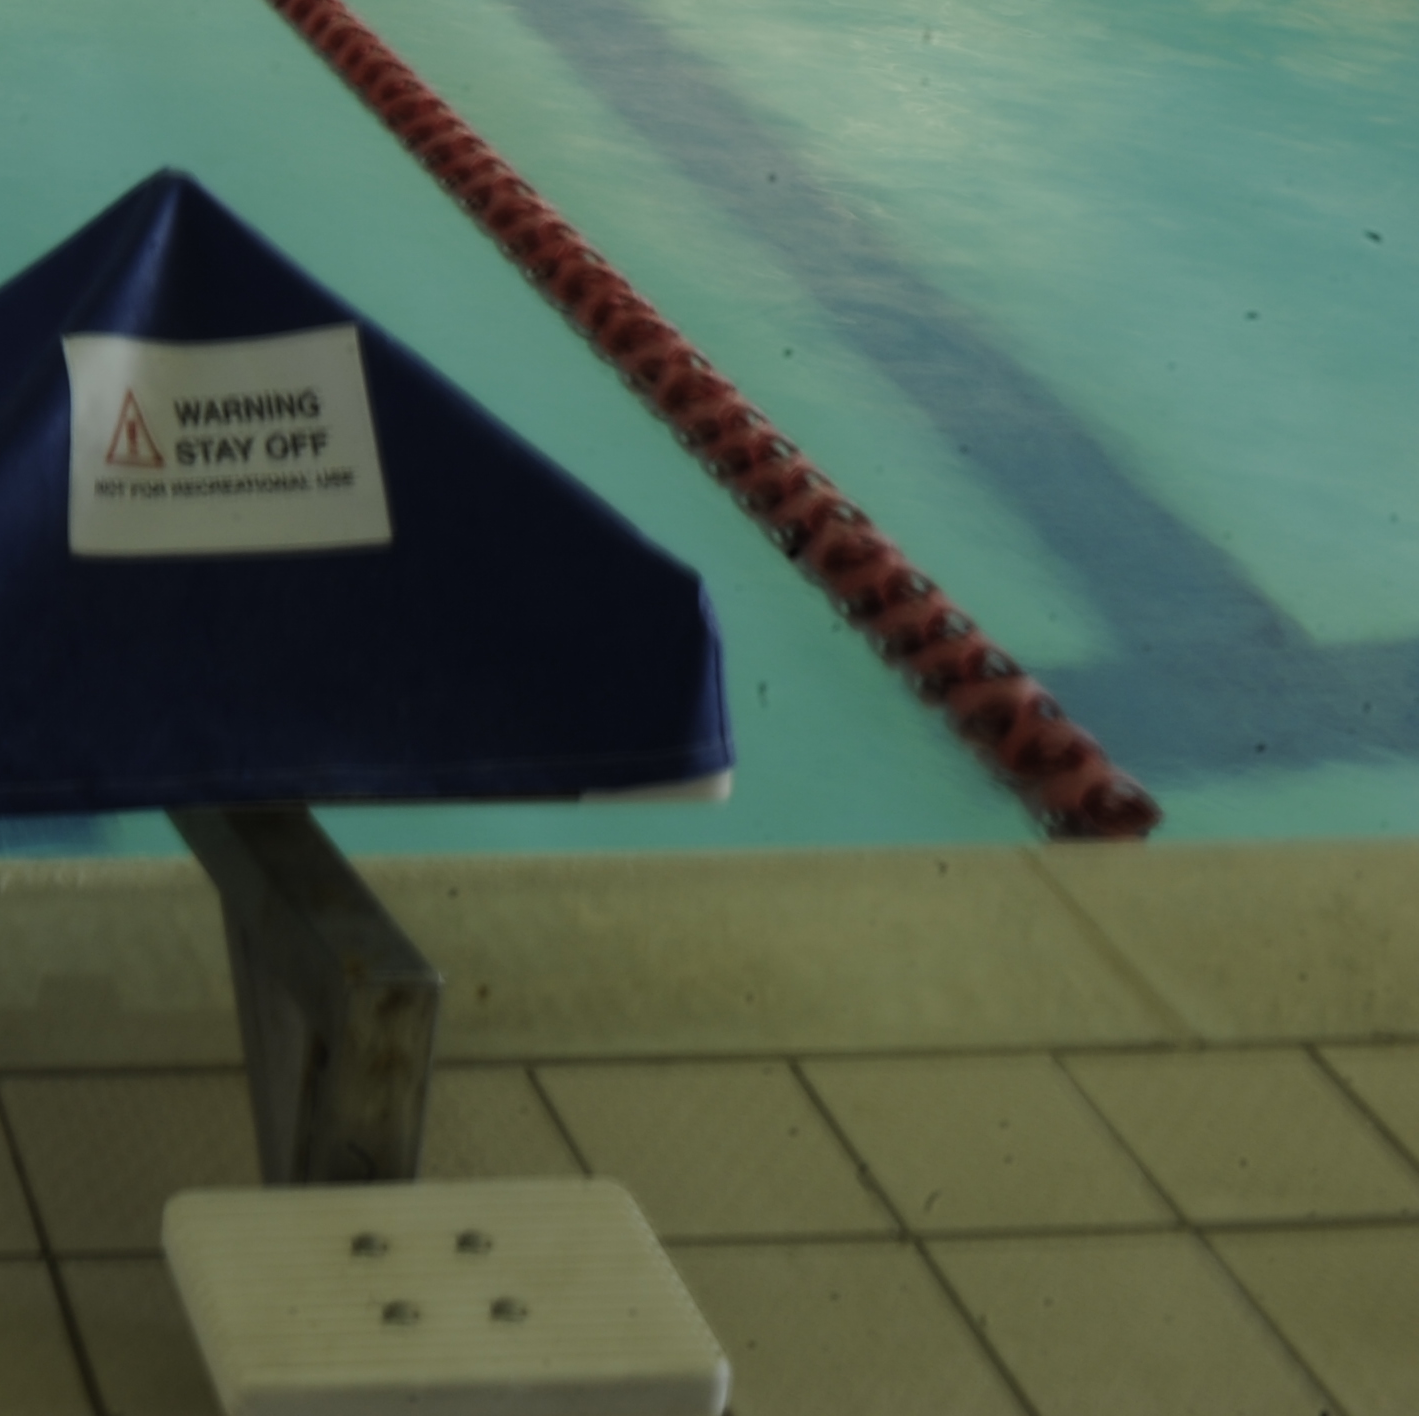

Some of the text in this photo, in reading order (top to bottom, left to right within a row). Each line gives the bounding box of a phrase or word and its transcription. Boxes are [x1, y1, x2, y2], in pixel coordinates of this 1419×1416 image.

[174, 390, 321, 426] WARNING
[175, 430, 329, 466] STAY OFF
[130, 478, 167, 499] FOR
[171, 473, 310, 498] RECREATIONAL
